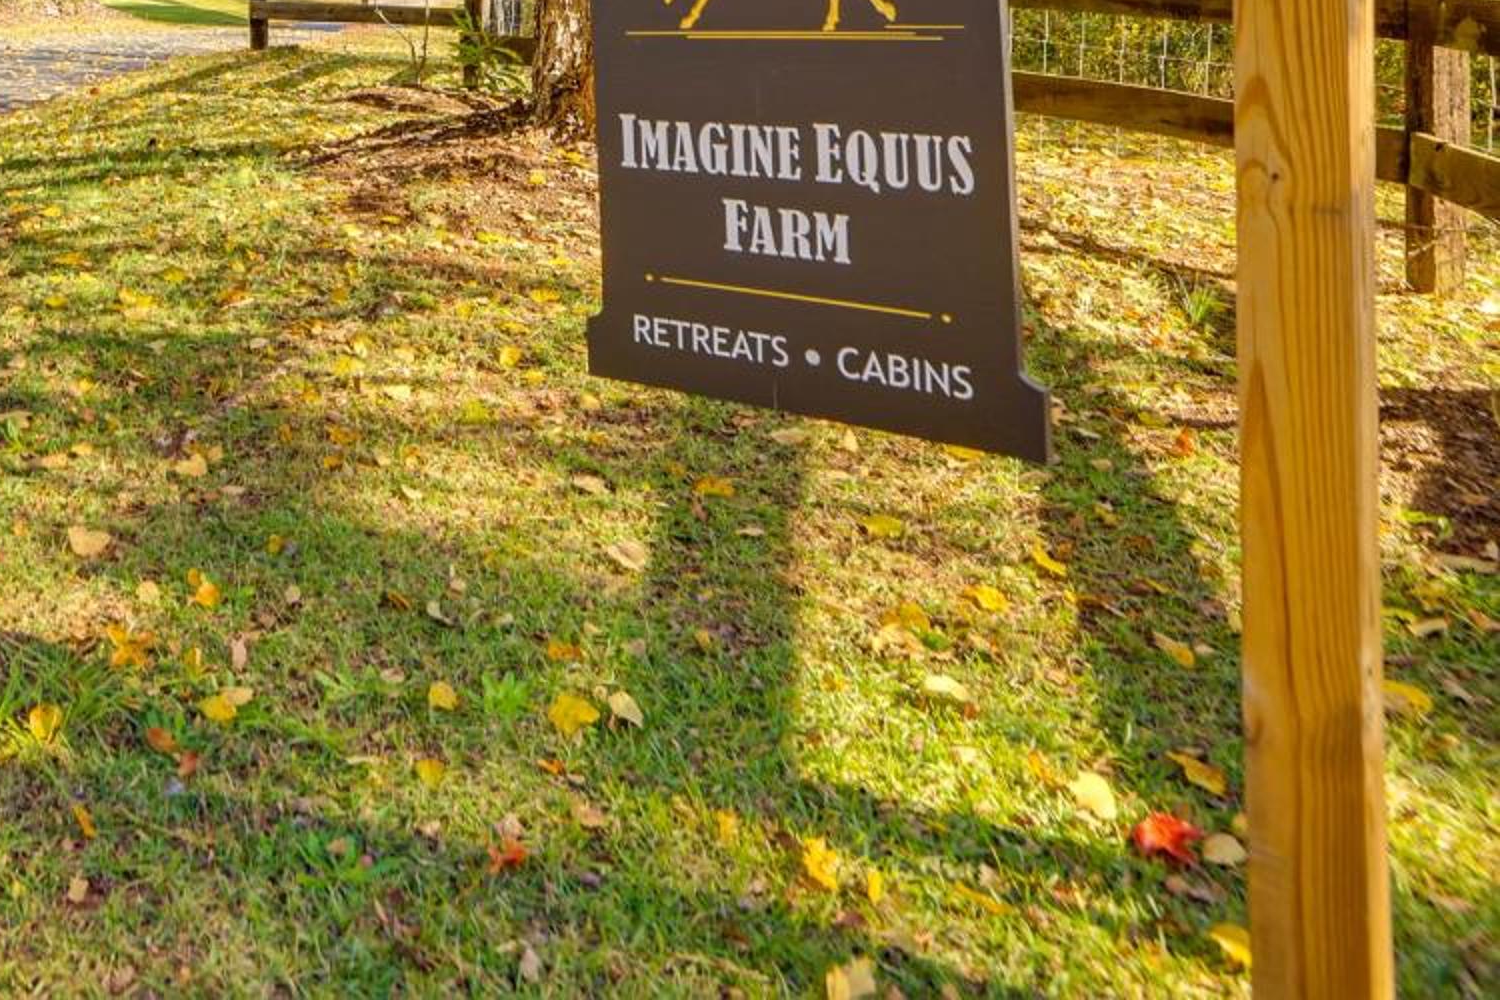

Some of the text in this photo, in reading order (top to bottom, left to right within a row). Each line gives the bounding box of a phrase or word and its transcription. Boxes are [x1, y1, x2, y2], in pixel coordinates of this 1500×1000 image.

[618, 113, 975, 196] IMAGINE EQUUS
[722, 198, 851, 264] FARM
[633, 315, 974, 400] RETREATS CABINS
